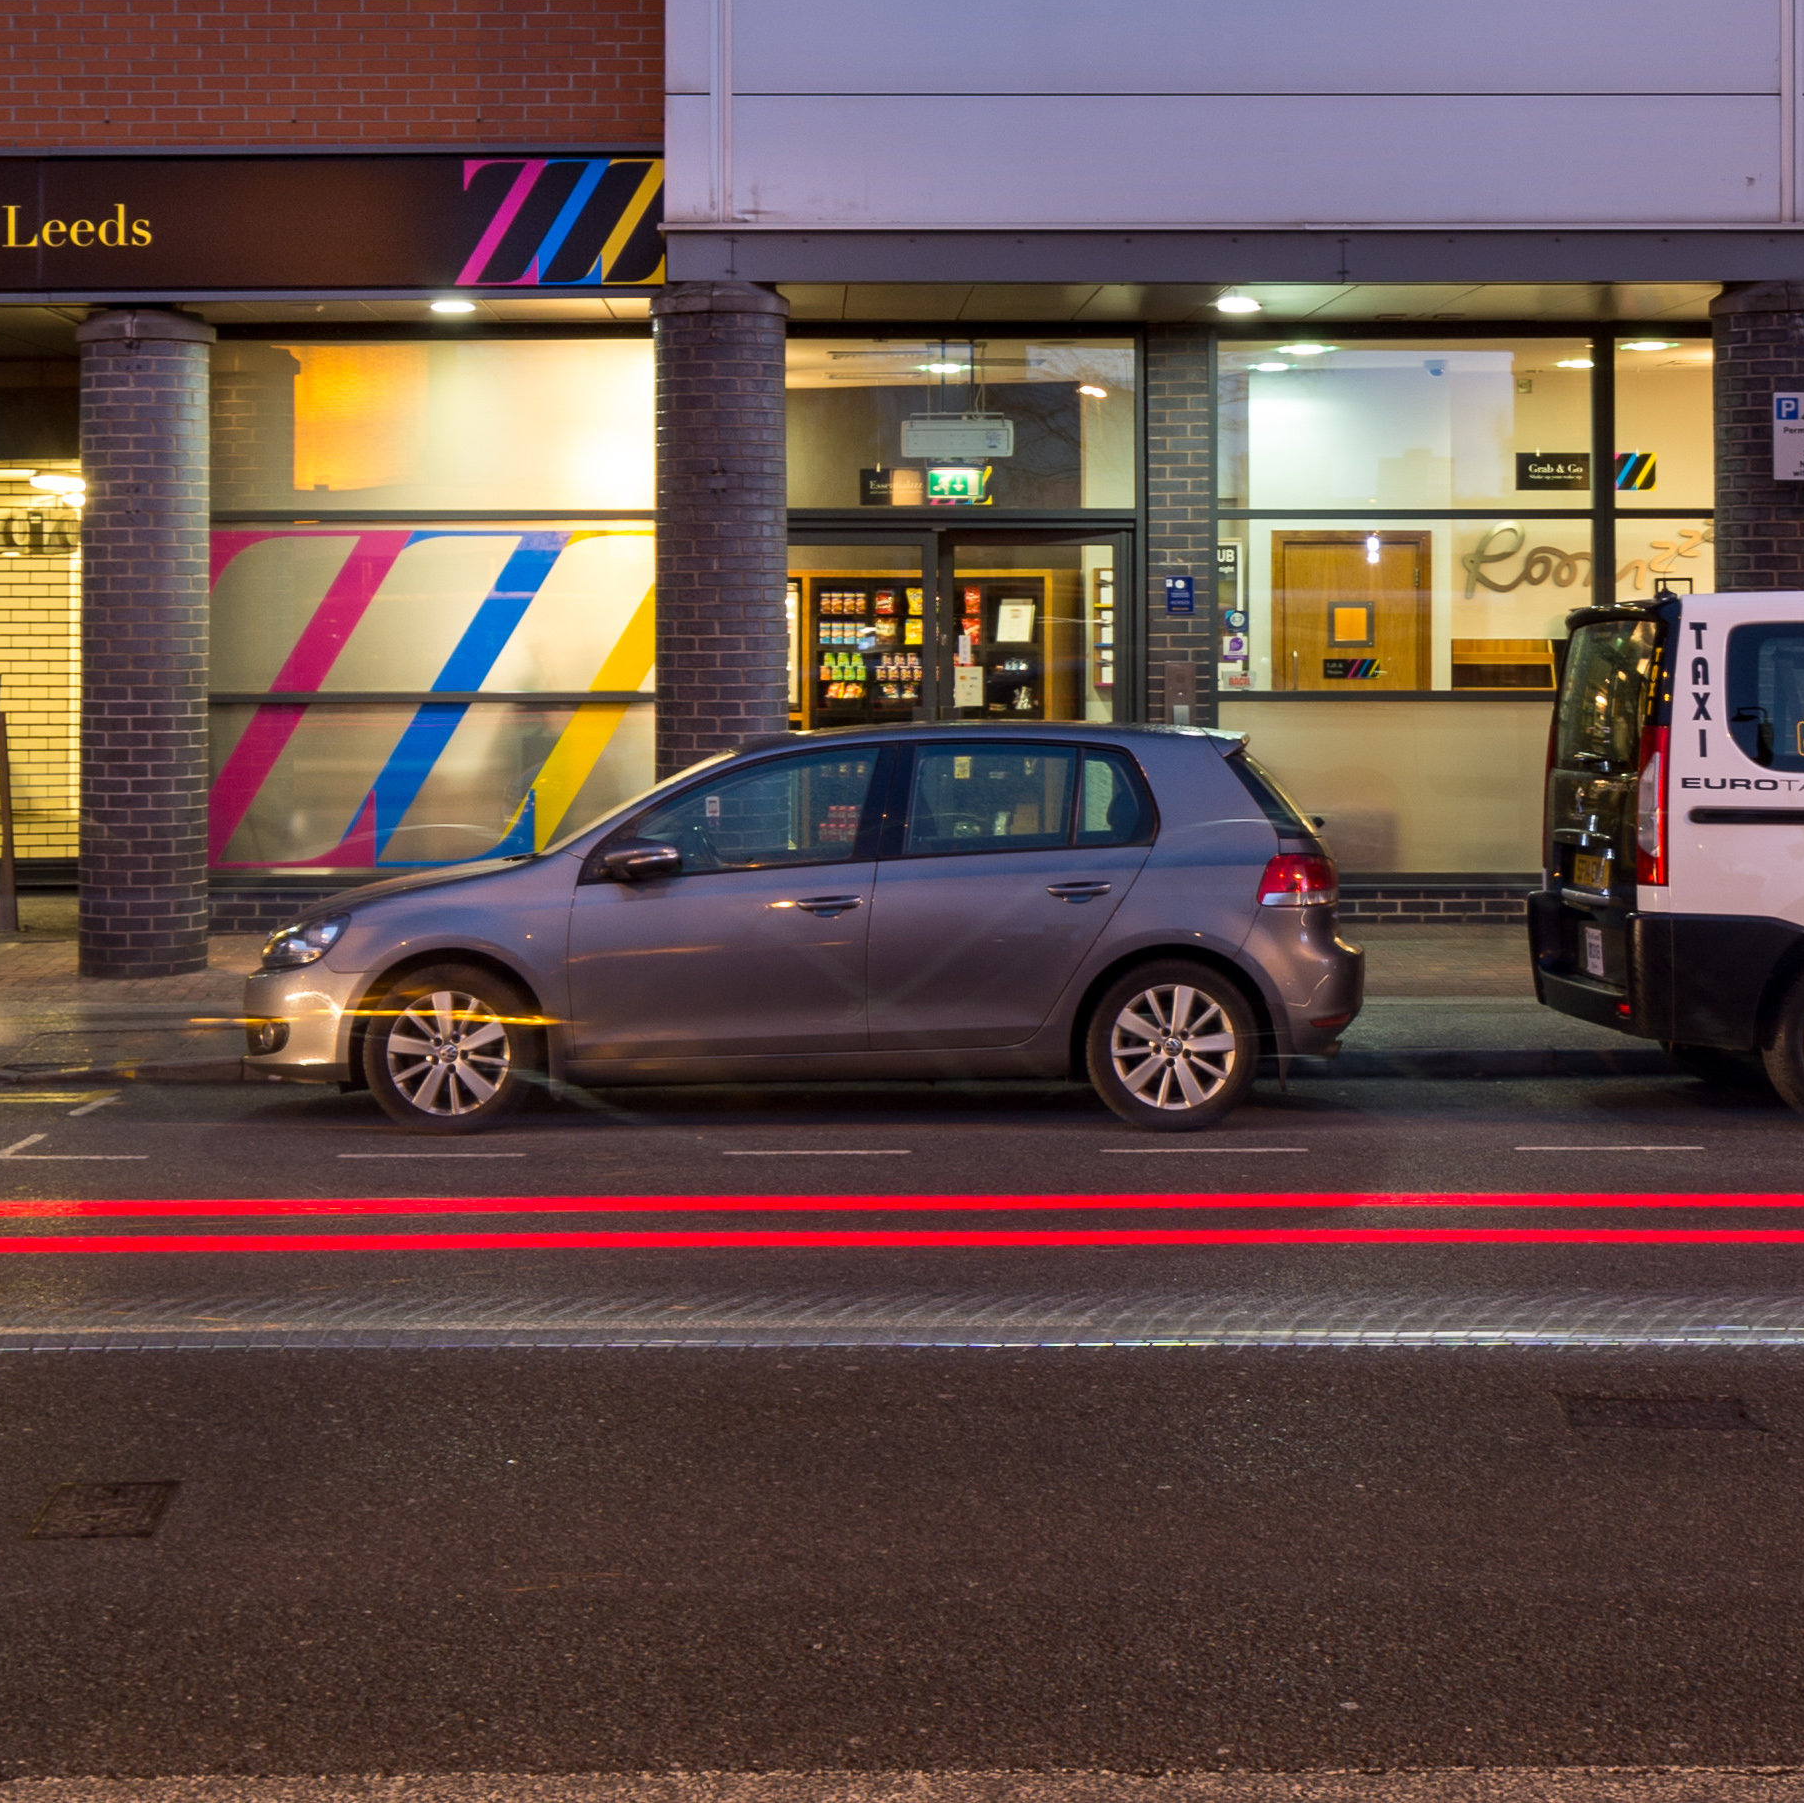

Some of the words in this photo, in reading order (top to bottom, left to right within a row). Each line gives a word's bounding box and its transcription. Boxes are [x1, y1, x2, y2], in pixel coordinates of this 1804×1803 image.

[1, 203, 153, 248] Leeds
[1528, 463, 1554, 473] Grab
[1556, 463, 1565, 473] &
[1567, 463, 1584, 473] Go
[1689, 622, 1712, 757] TAXI
